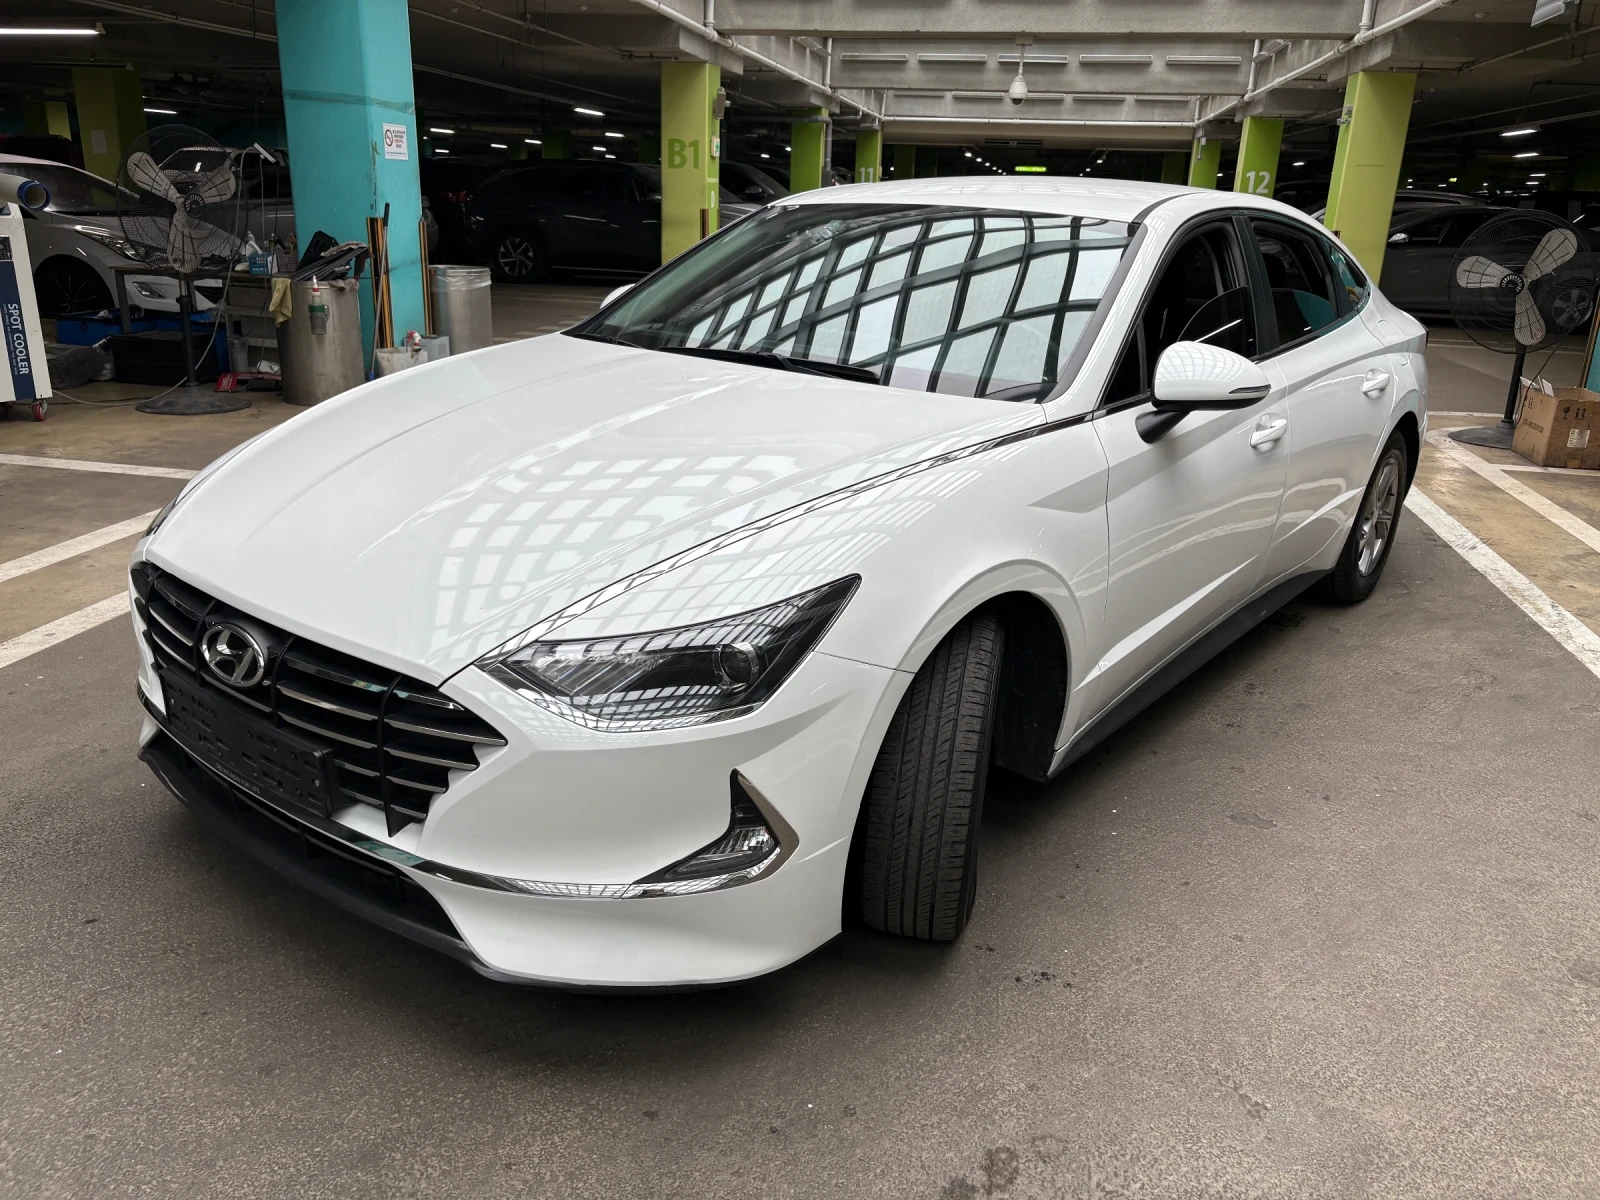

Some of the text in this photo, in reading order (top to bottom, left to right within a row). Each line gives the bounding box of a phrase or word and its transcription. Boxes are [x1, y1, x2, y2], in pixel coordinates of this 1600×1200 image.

[667, 138, 700, 169] B1
[859, 167, 874, 183] 11
[1245, 170, 1271, 194] 12
[7, 303, 22, 331] SPOT
[13, 332, 29, 375] COOLER
